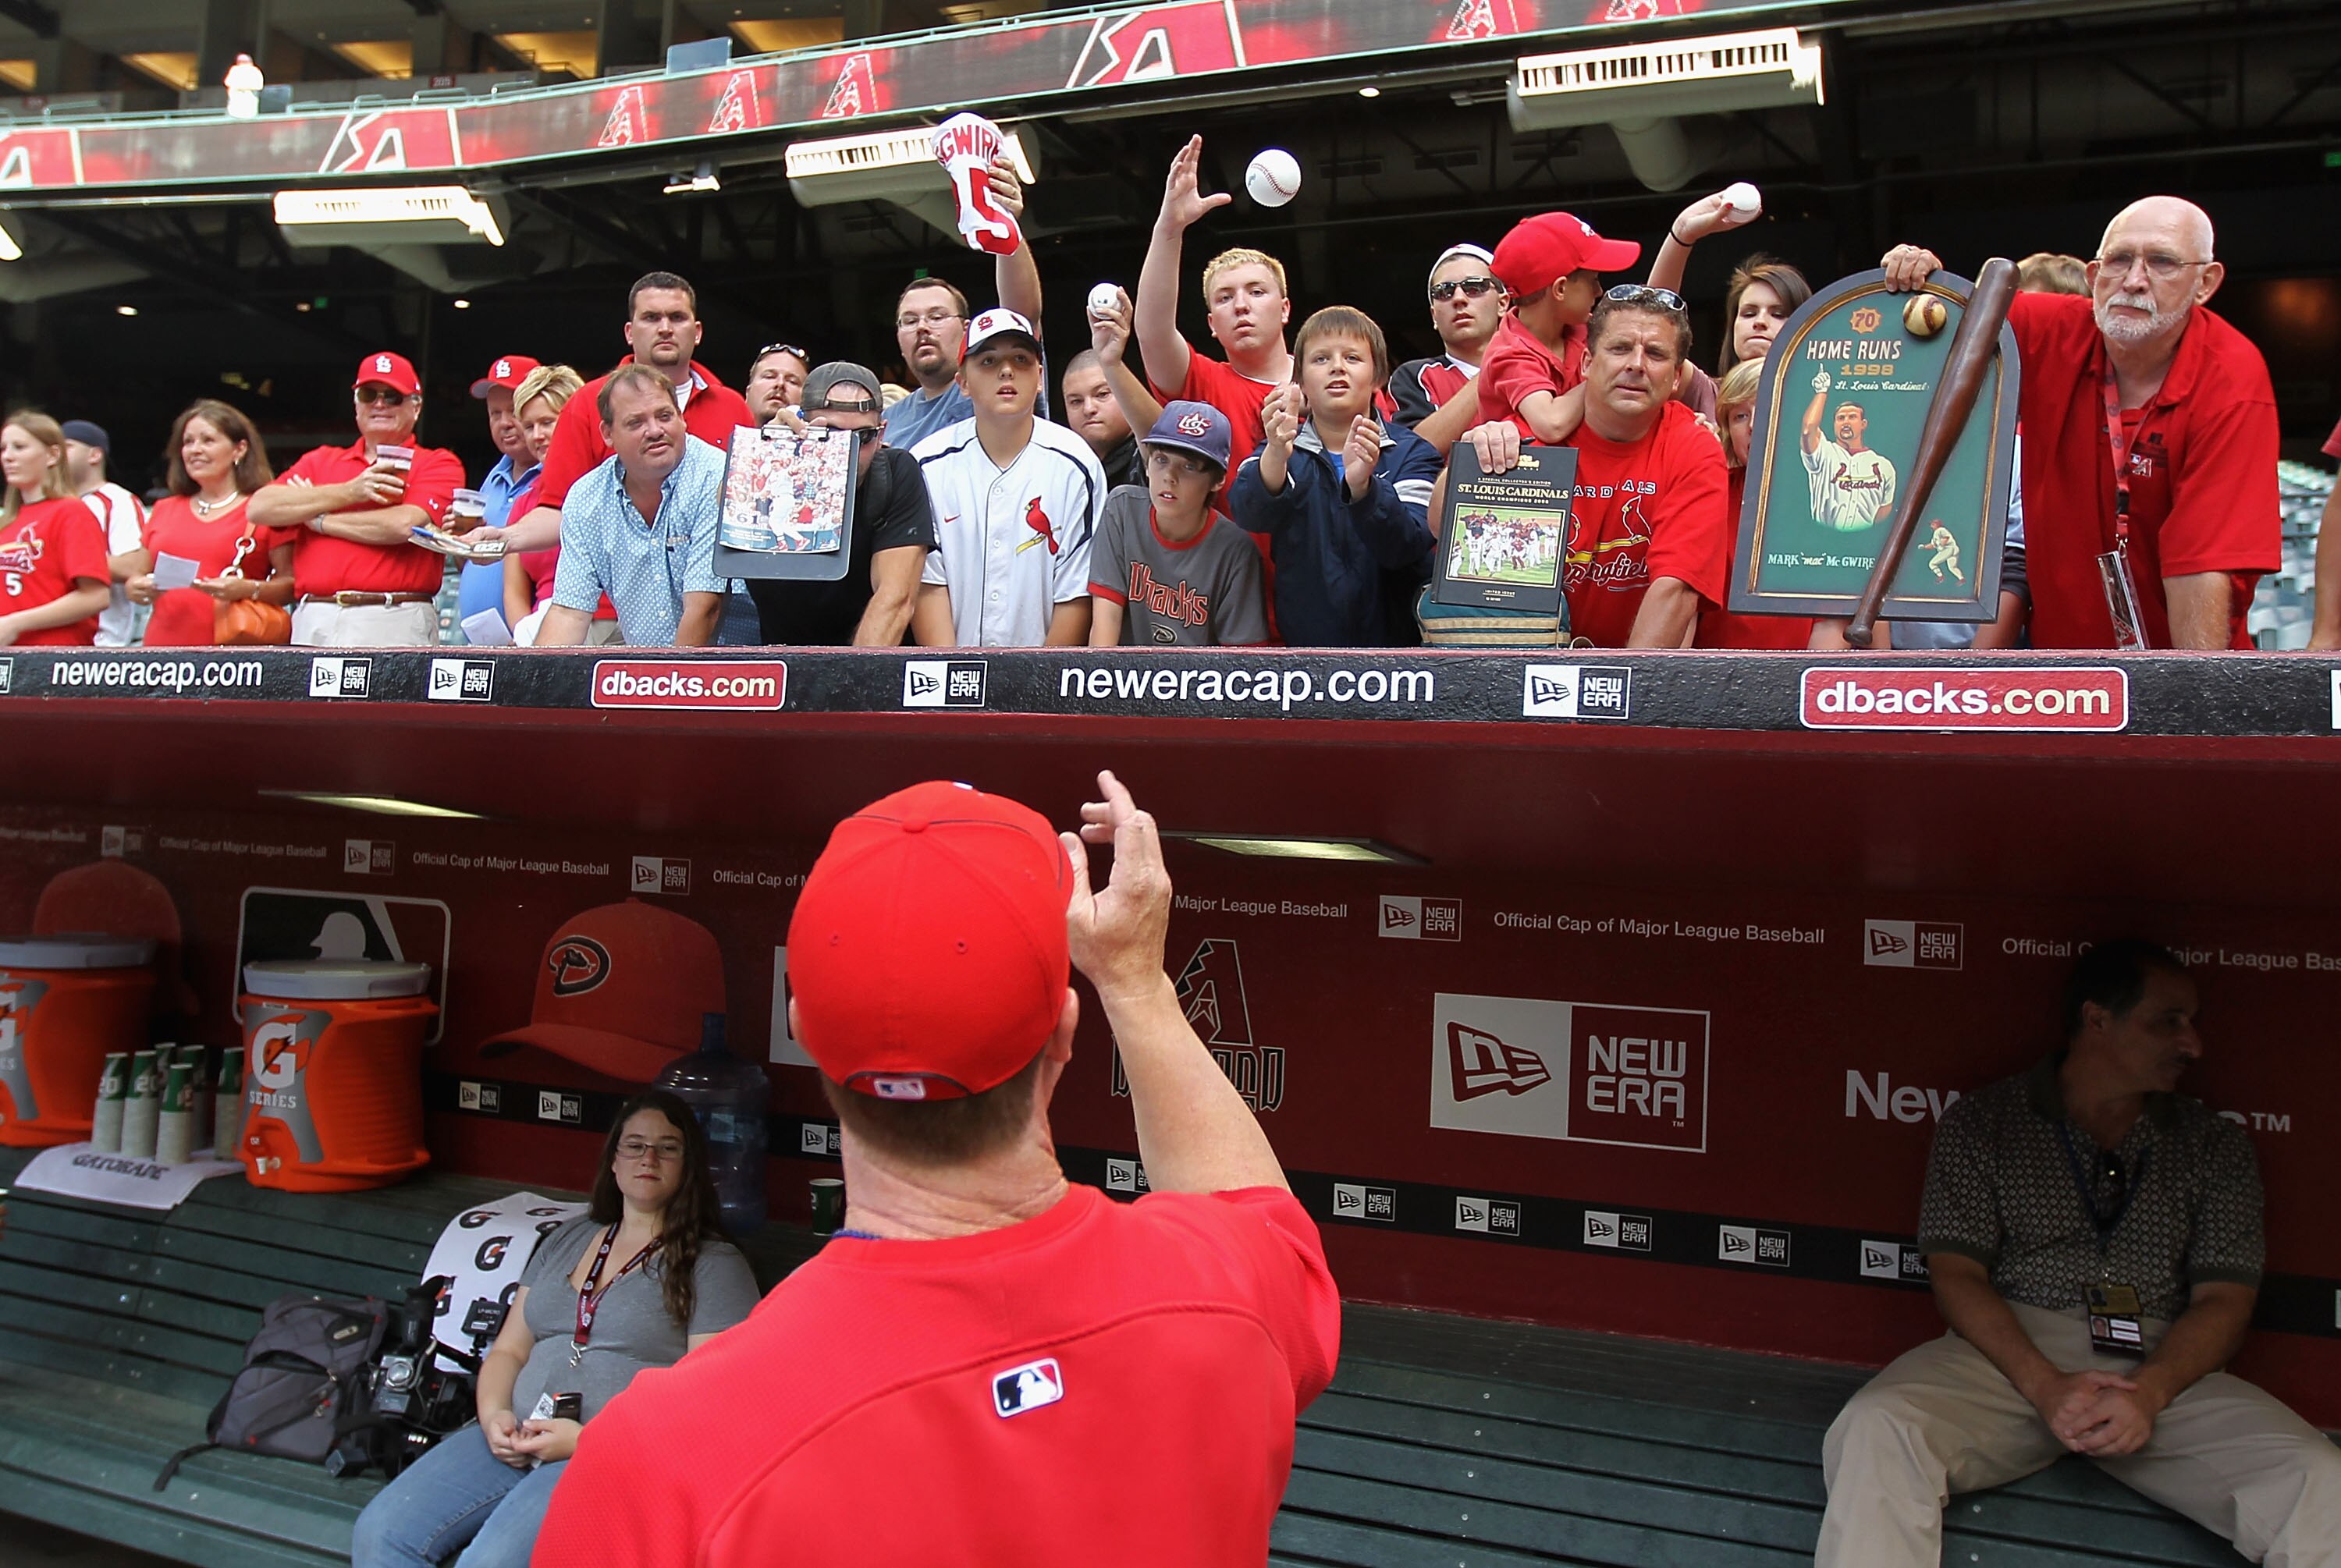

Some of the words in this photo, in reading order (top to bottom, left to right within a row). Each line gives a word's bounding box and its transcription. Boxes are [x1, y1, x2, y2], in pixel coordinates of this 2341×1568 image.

[1854, 313, 1875, 327] 70
[1806, 340, 1853, 360] HOME
[1857, 340, 1902, 360] RUNS
[1840, 364, 1894, 375] 1998
[1850, 381, 1879, 390] Louis
[1458, 484, 1472, 493] ST.
[1473, 484, 1504, 495] LOUIS
[1506, 487, 1568, 499] CARDINALS
[1768, 554, 1799, 568] MARK
[5, 572, 23, 596] 5
[52, 659, 263, 692] neweracap.com
[344, 666, 366, 678] NEW
[465, 669, 489, 680] NEW
[950, 671, 980, 683] NEW
[343, 677, 364, 689] ERA
[464, 679, 488, 692] ERA
[601, 671, 776, 697] dbacks.com
[950, 683, 979, 697] ERA
[1060, 665, 1434, 711] neweracap.com
[1583, 677, 1622, 693] NEW
[1583, 692, 1622, 707] ERA
[1817, 681, 2109, 715] dbacks.com
[250, 843, 284, 857] League
[286, 844, 326, 857] Baseball
[413, 852, 447, 865] Official
[449, 854, 471, 868] Cap
[474, 856, 485, 867] of
[487, 857, 517, 872] Major
[520, 859, 559, 874] League
[562, 861, 609, 875] Baseball
[665, 866, 687, 876] NEW
[665, 875, 686, 887] ERA
[712, 869, 755, 885] Official
[757, 872, 782, 888] Cap
[785, 874, 798, 886] of
[1174, 895, 1217, 913] Major
[1221, 897, 1277, 916] League
[1281, 901, 1348, 918] Baseball
[1426, 906, 1455, 920] NEW
[1426, 919, 1455, 932] ERA
[1494, 911, 1552, 929] Official
[1557, 915, 1592, 933] Cap
[1597, 917, 1615, 932] of
[1619, 918, 1669, 938] Major
[1675, 921, 1740, 942] League
[1746, 925, 1824, 943] Baseball
[1920, 932, 1956, 945] NEW
[1920, 945, 1955, 960] ERA
[2002, 938, 2070, 957] Official
[2166, 946, 2213, 967] ajor
[2219, 949, 2299, 971] League
[1588, 1035, 1686, 1077] NEW
[249, 1091, 297, 1109] SERIES
[1586, 1076, 1686, 1118] ERA
[829, 1133, 840, 1142] NE
[829, 1141, 840, 1150] ER
[1368, 1194, 1391, 1204] NEW
[1368, 1203, 1391, 1214] ERA
[1492, 1208, 1515, 1219] NEW
[1492, 1217, 1515, 1229] ERA
[1623, 1222, 1647, 1233] NEW
[1622, 1232, 1646, 1243] ERA
[1760, 1236, 1785, 1249] NEW
[1759, 1247, 1785, 1260] ERA
[1903, 1252, 1920, 1263] NE
